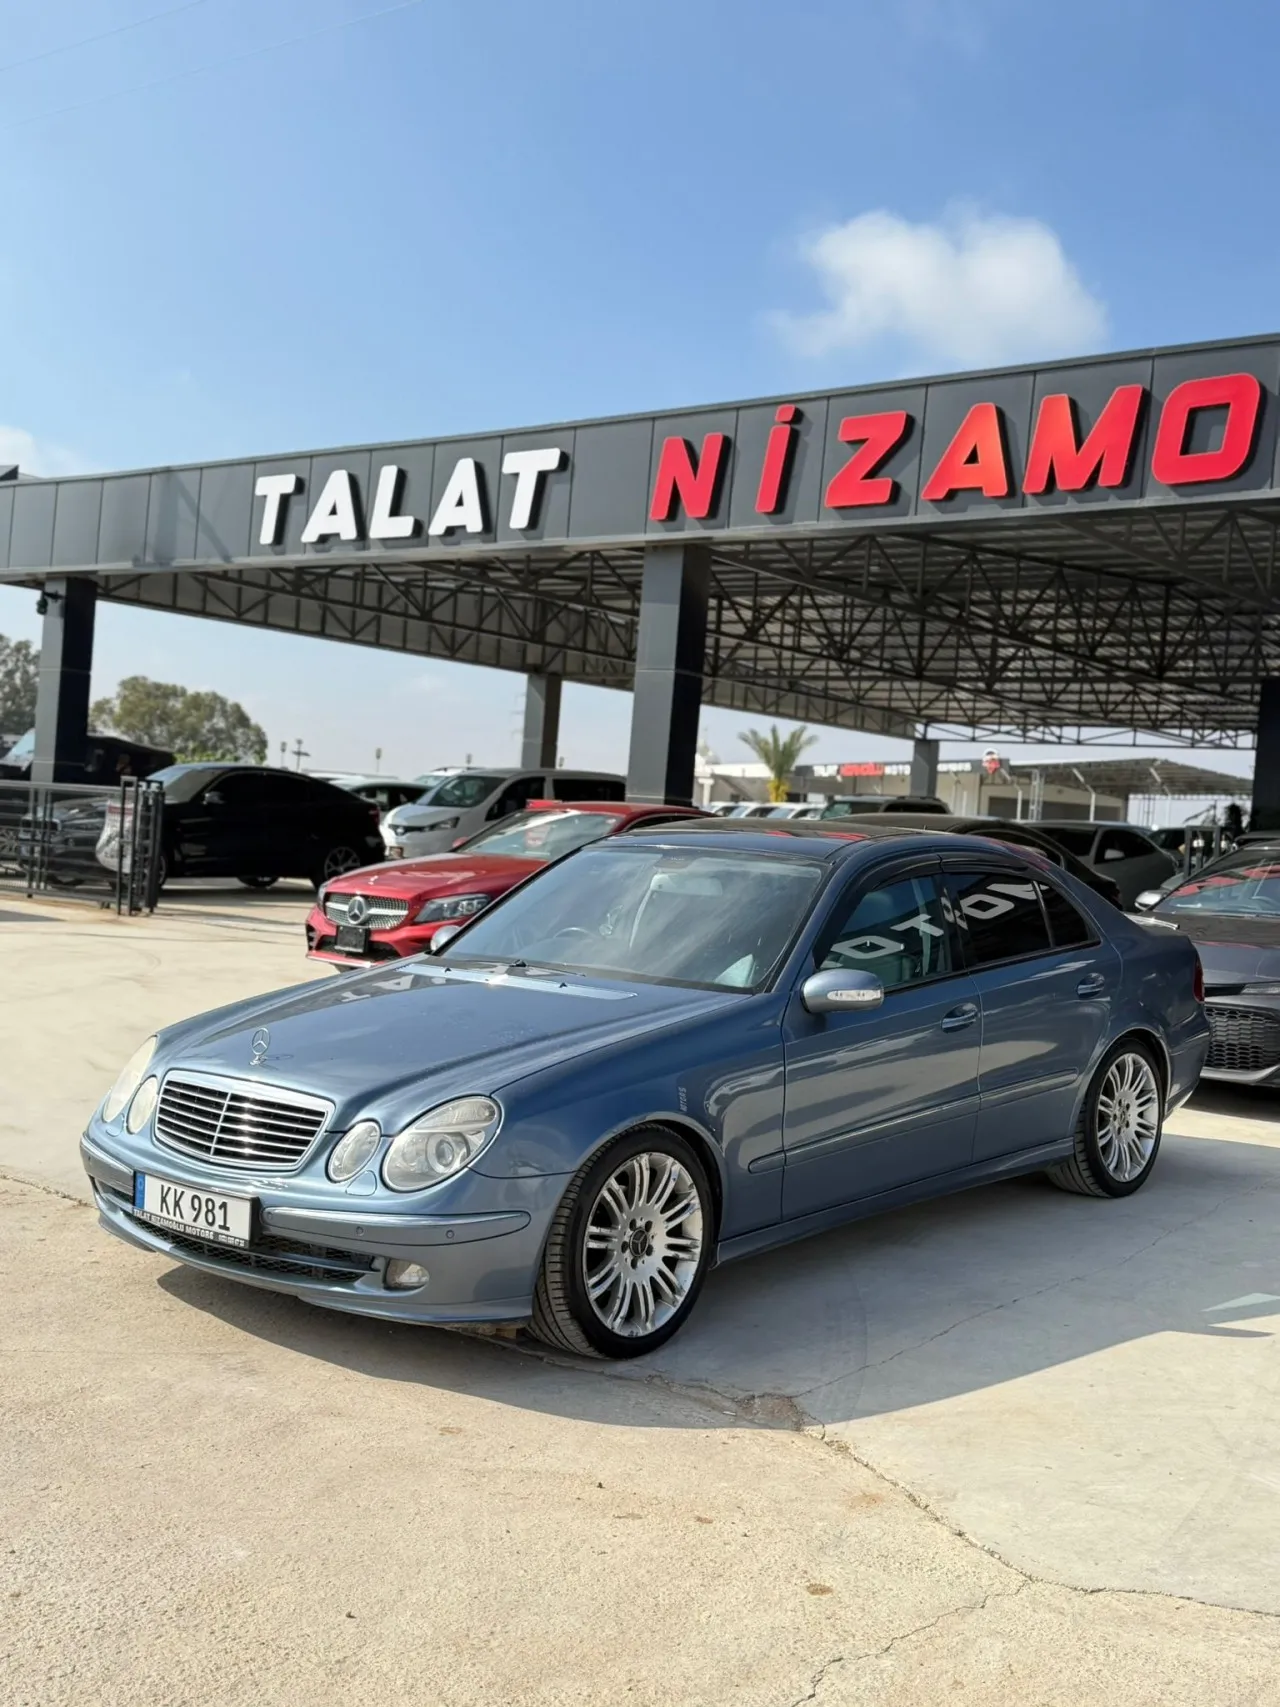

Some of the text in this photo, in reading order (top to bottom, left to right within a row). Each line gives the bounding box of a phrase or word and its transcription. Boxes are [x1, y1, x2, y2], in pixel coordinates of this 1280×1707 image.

[255, 372, 1262, 545] TALAT NİZAMO
[160, 1184, 230, 1231] KK 981
[185, 1225, 214, 1240] MOTORS
